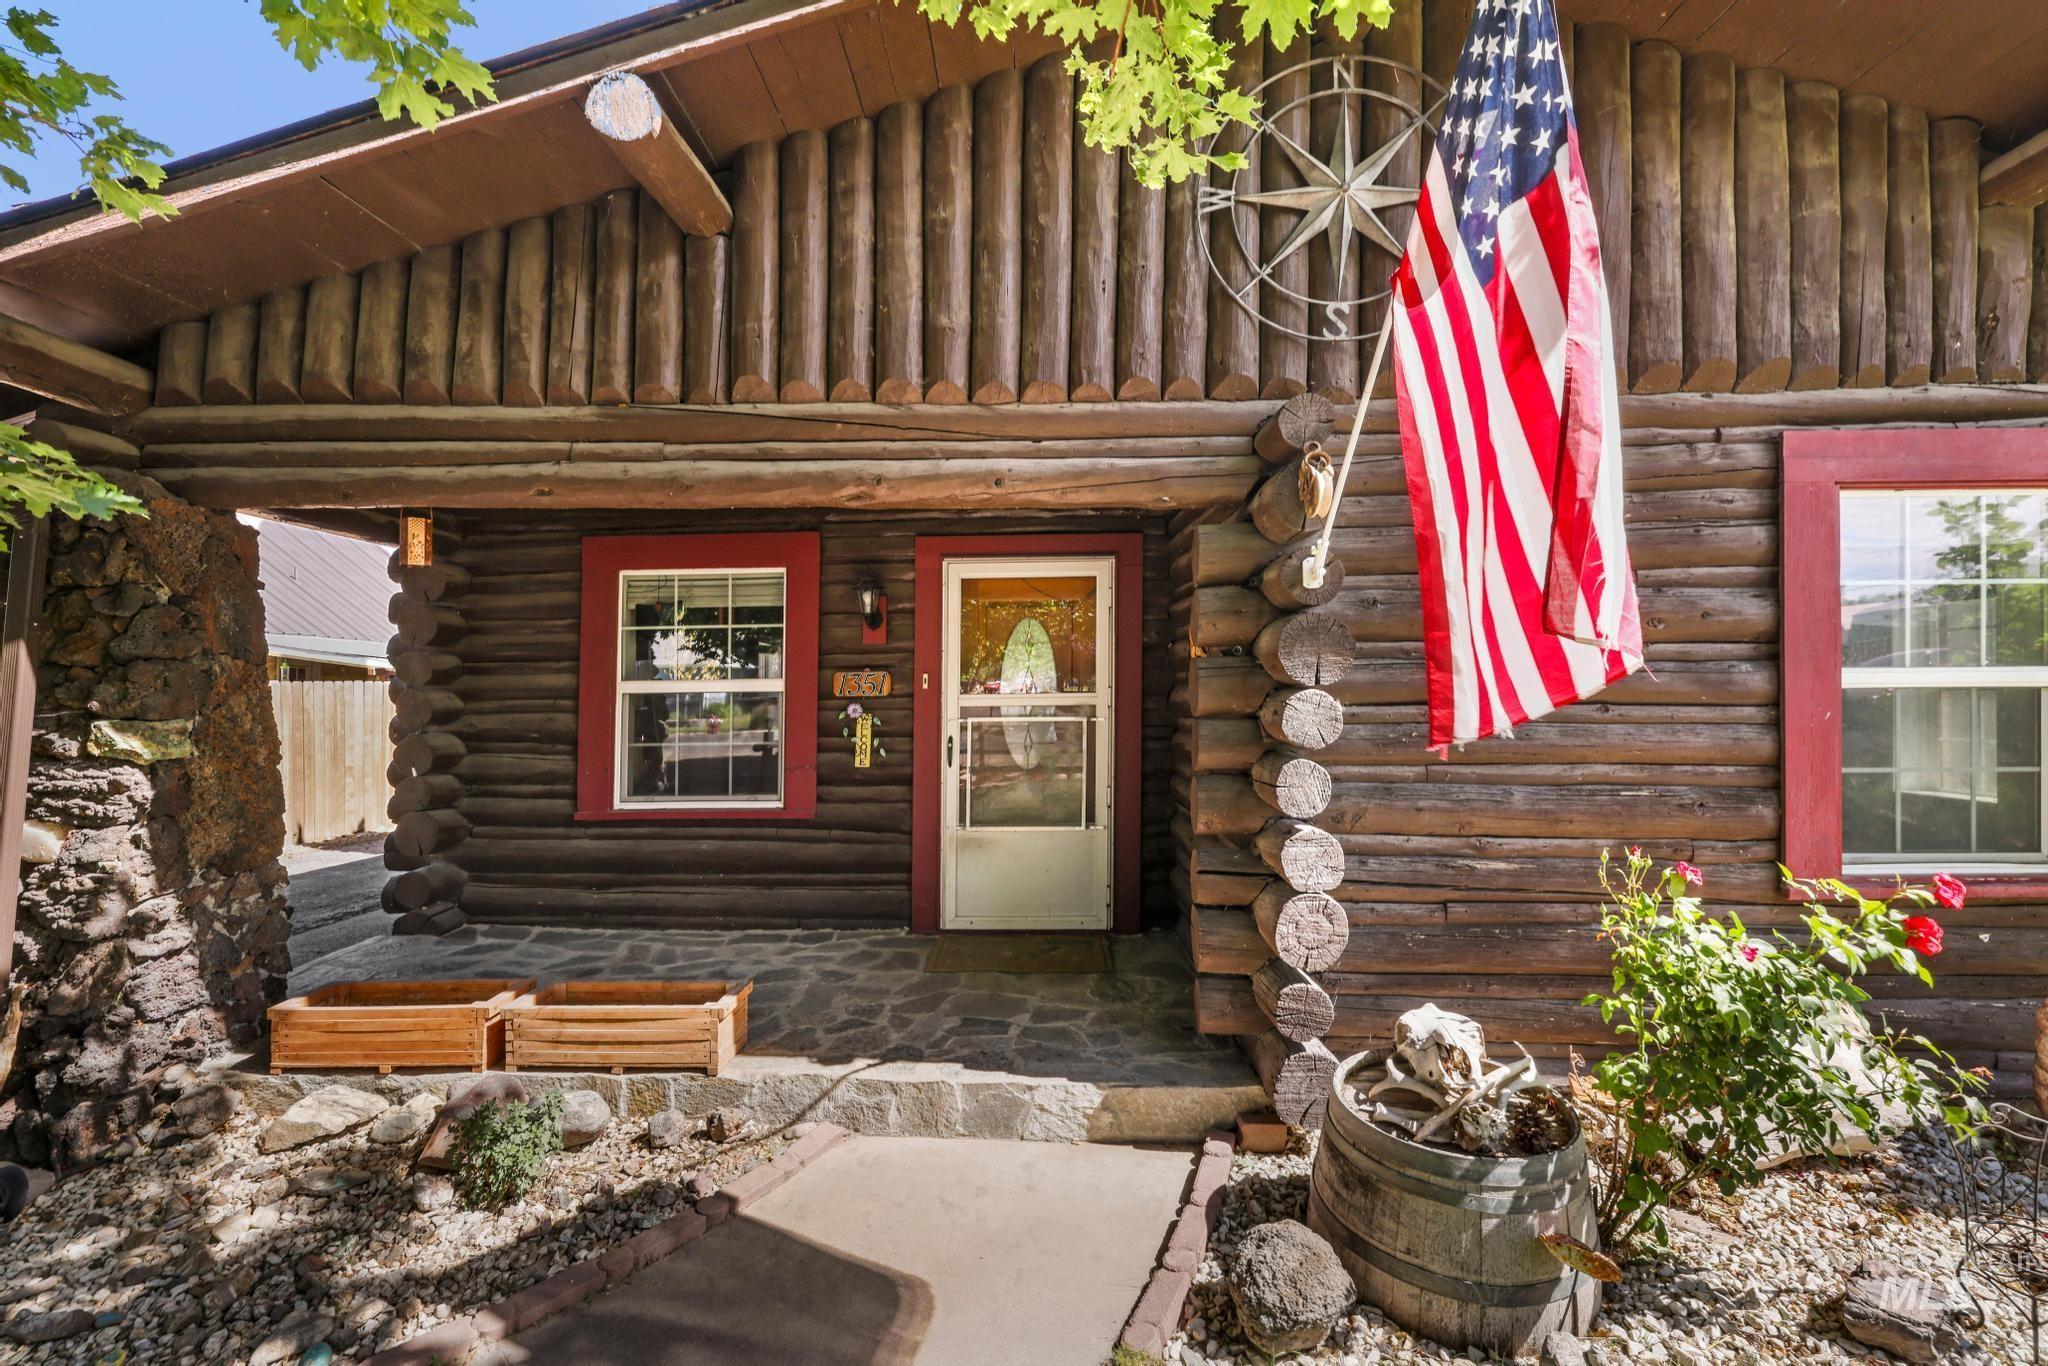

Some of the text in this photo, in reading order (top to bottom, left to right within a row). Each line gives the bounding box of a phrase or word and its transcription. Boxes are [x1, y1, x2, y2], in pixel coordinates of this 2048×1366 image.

[1333, 57, 1355, 90] N
[1323, 304, 1350, 339] S
[837, 671, 888, 697] 1351
[860, 714, 869, 766] WELCOME
